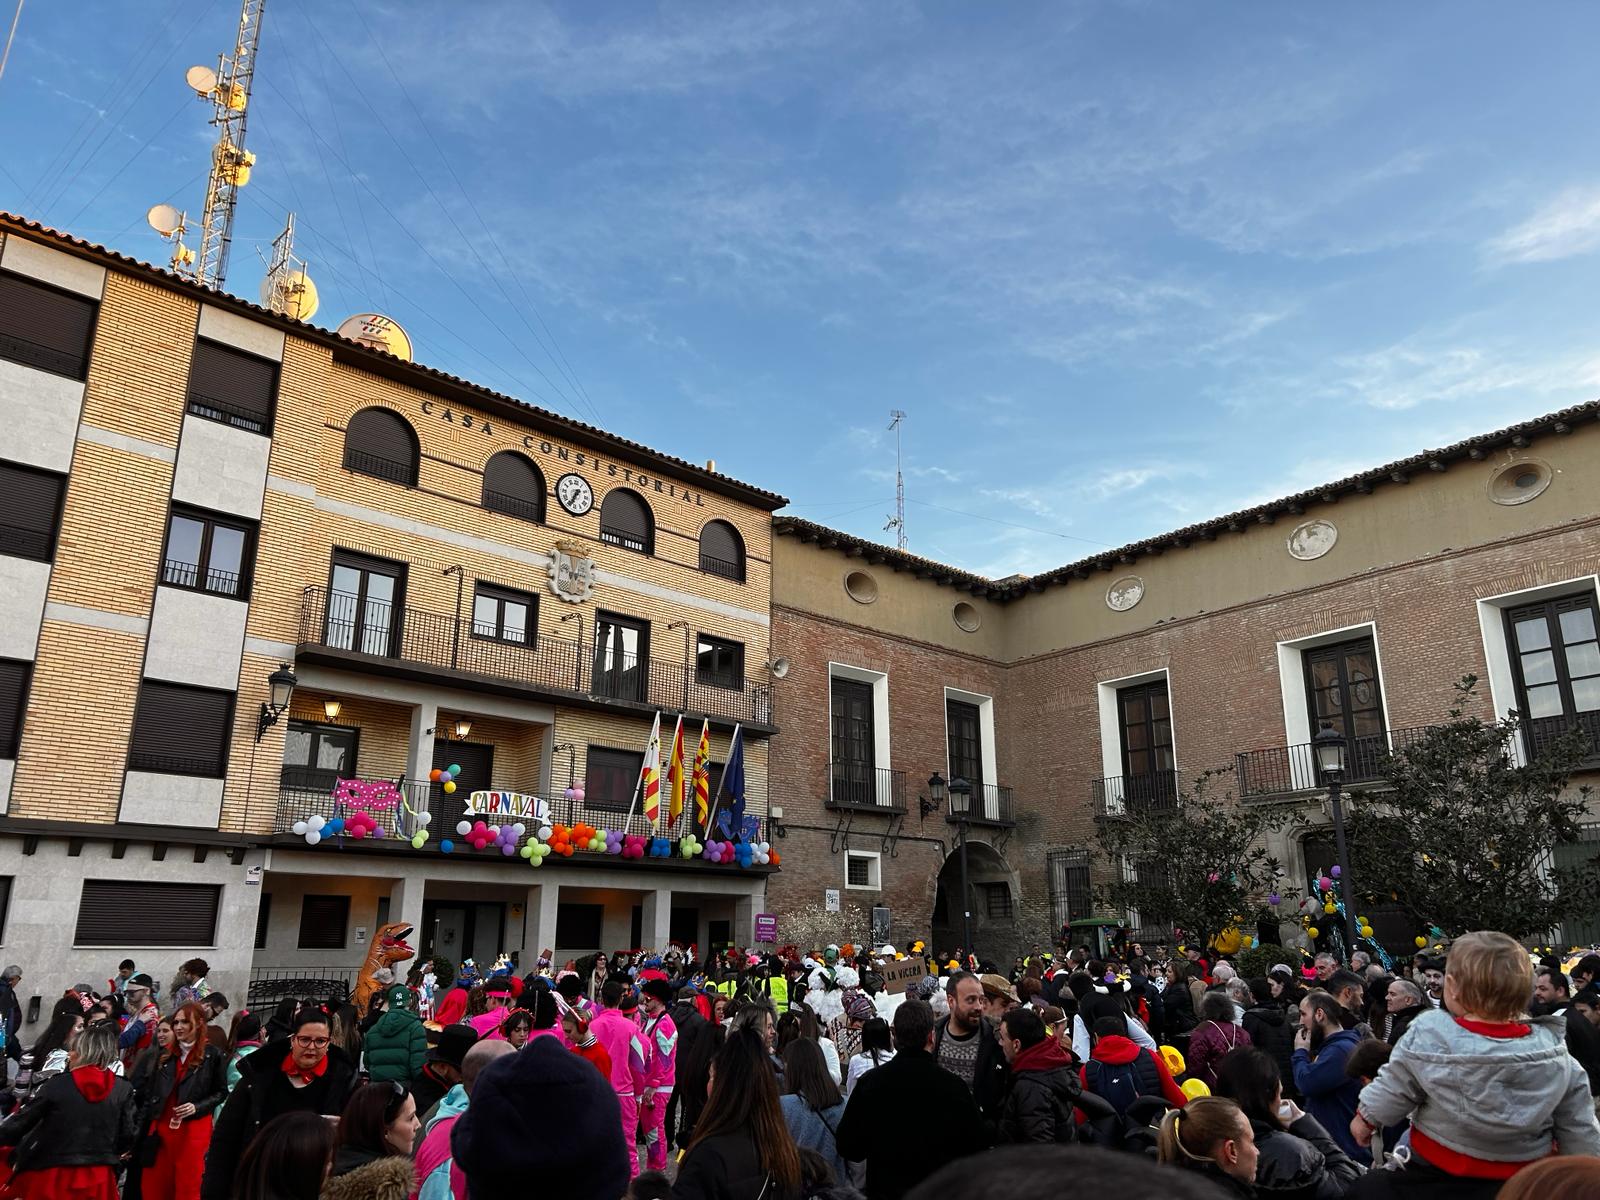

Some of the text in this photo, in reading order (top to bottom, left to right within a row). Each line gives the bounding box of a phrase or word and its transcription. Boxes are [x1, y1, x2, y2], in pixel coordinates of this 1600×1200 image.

[421, 400, 493, 436] CASA
[523, 435, 705, 507] CONSISTORIAL
[472, 792, 544, 818] CARNAVAL
[887, 971, 897, 981] LA
